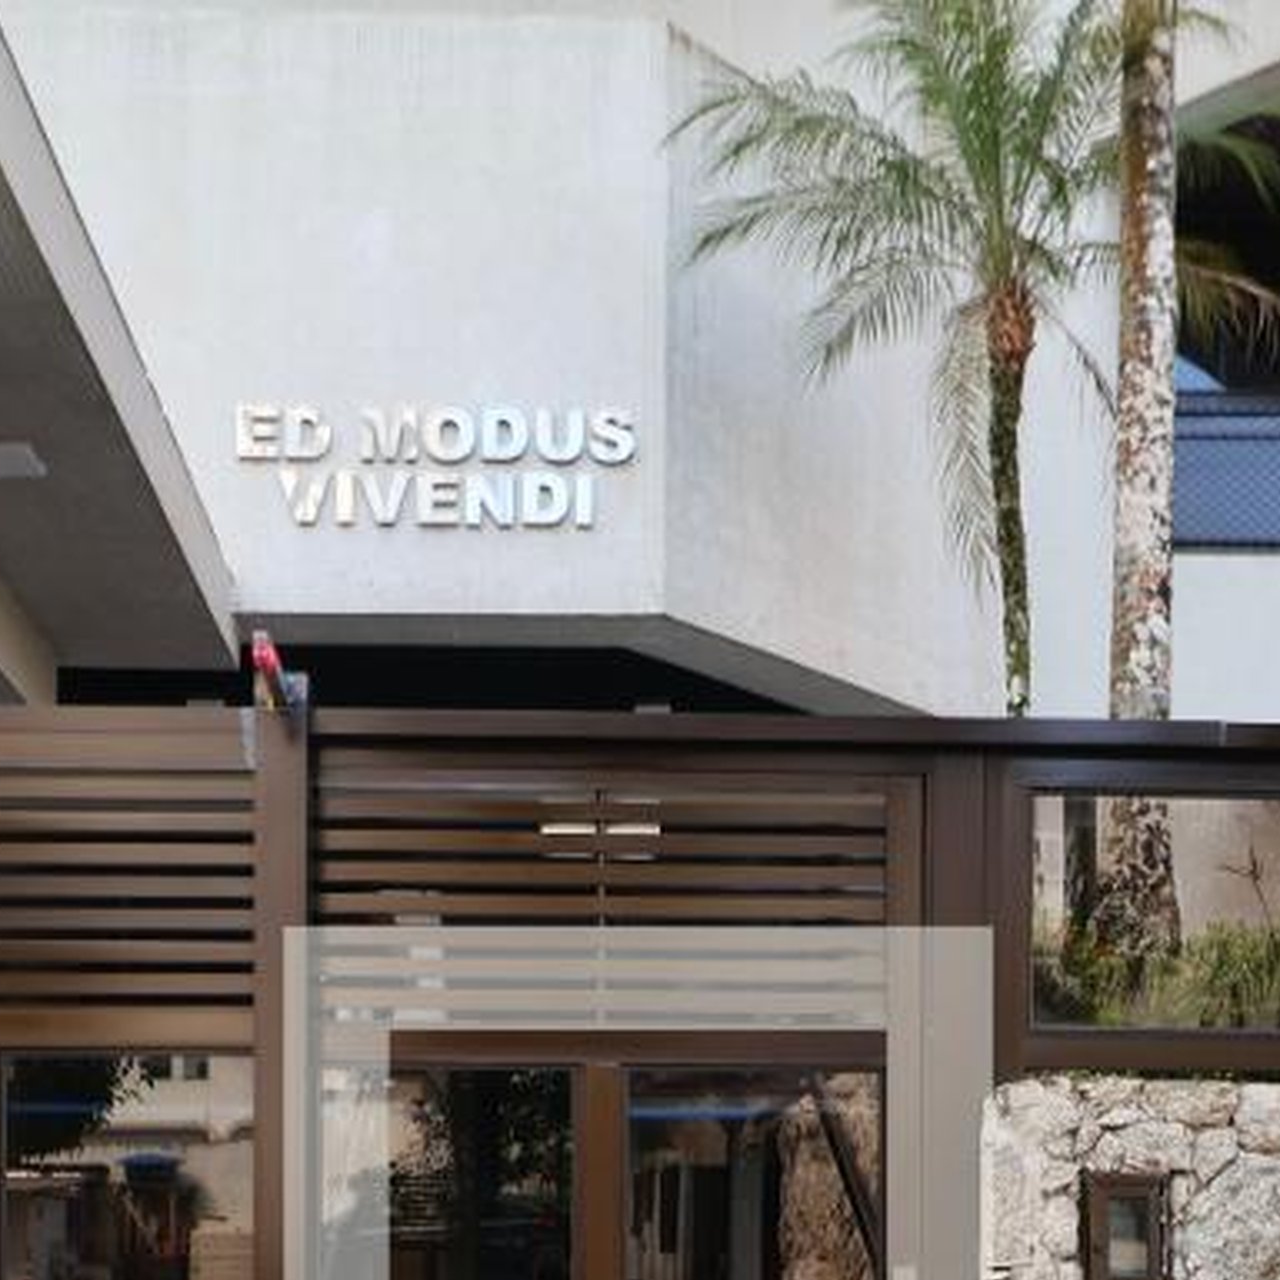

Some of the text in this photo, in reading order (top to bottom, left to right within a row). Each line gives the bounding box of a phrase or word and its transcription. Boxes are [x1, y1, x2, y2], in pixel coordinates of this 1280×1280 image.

[235, 402, 637, 466] ED MODUS
[280, 469, 594, 530] VIVENDI
